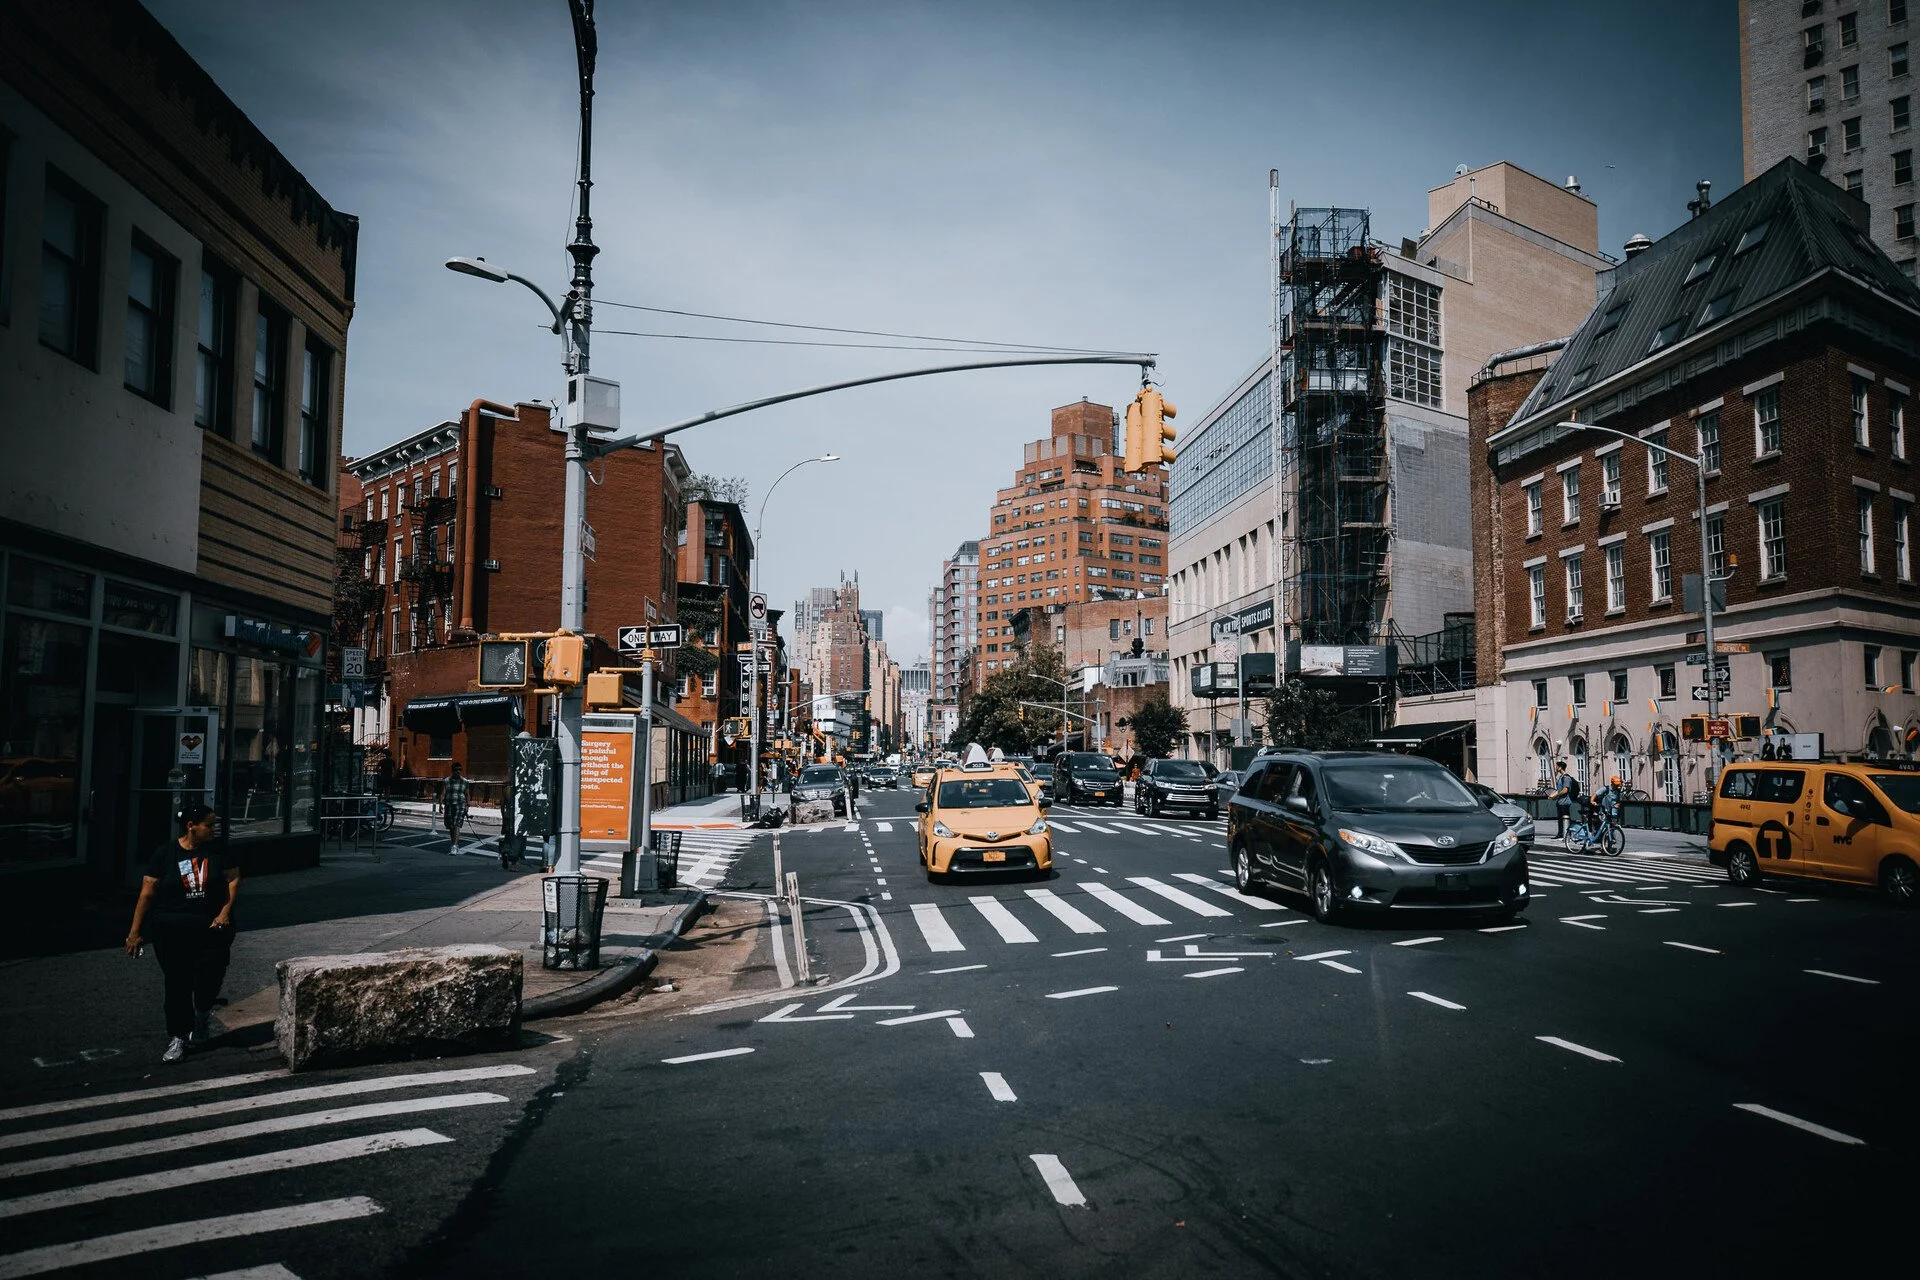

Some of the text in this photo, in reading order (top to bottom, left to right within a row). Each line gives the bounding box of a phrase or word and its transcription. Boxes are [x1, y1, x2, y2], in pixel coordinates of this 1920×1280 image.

[1241, 613, 1257, 628] SPORTS
[1257, 607, 1271, 623] CLUBS
[628, 631, 673, 643] ONE WAY
[346, 663, 363, 675] 20
[581, 740, 611, 748] Surgery
[1833, 835, 1853, 845] NYC
